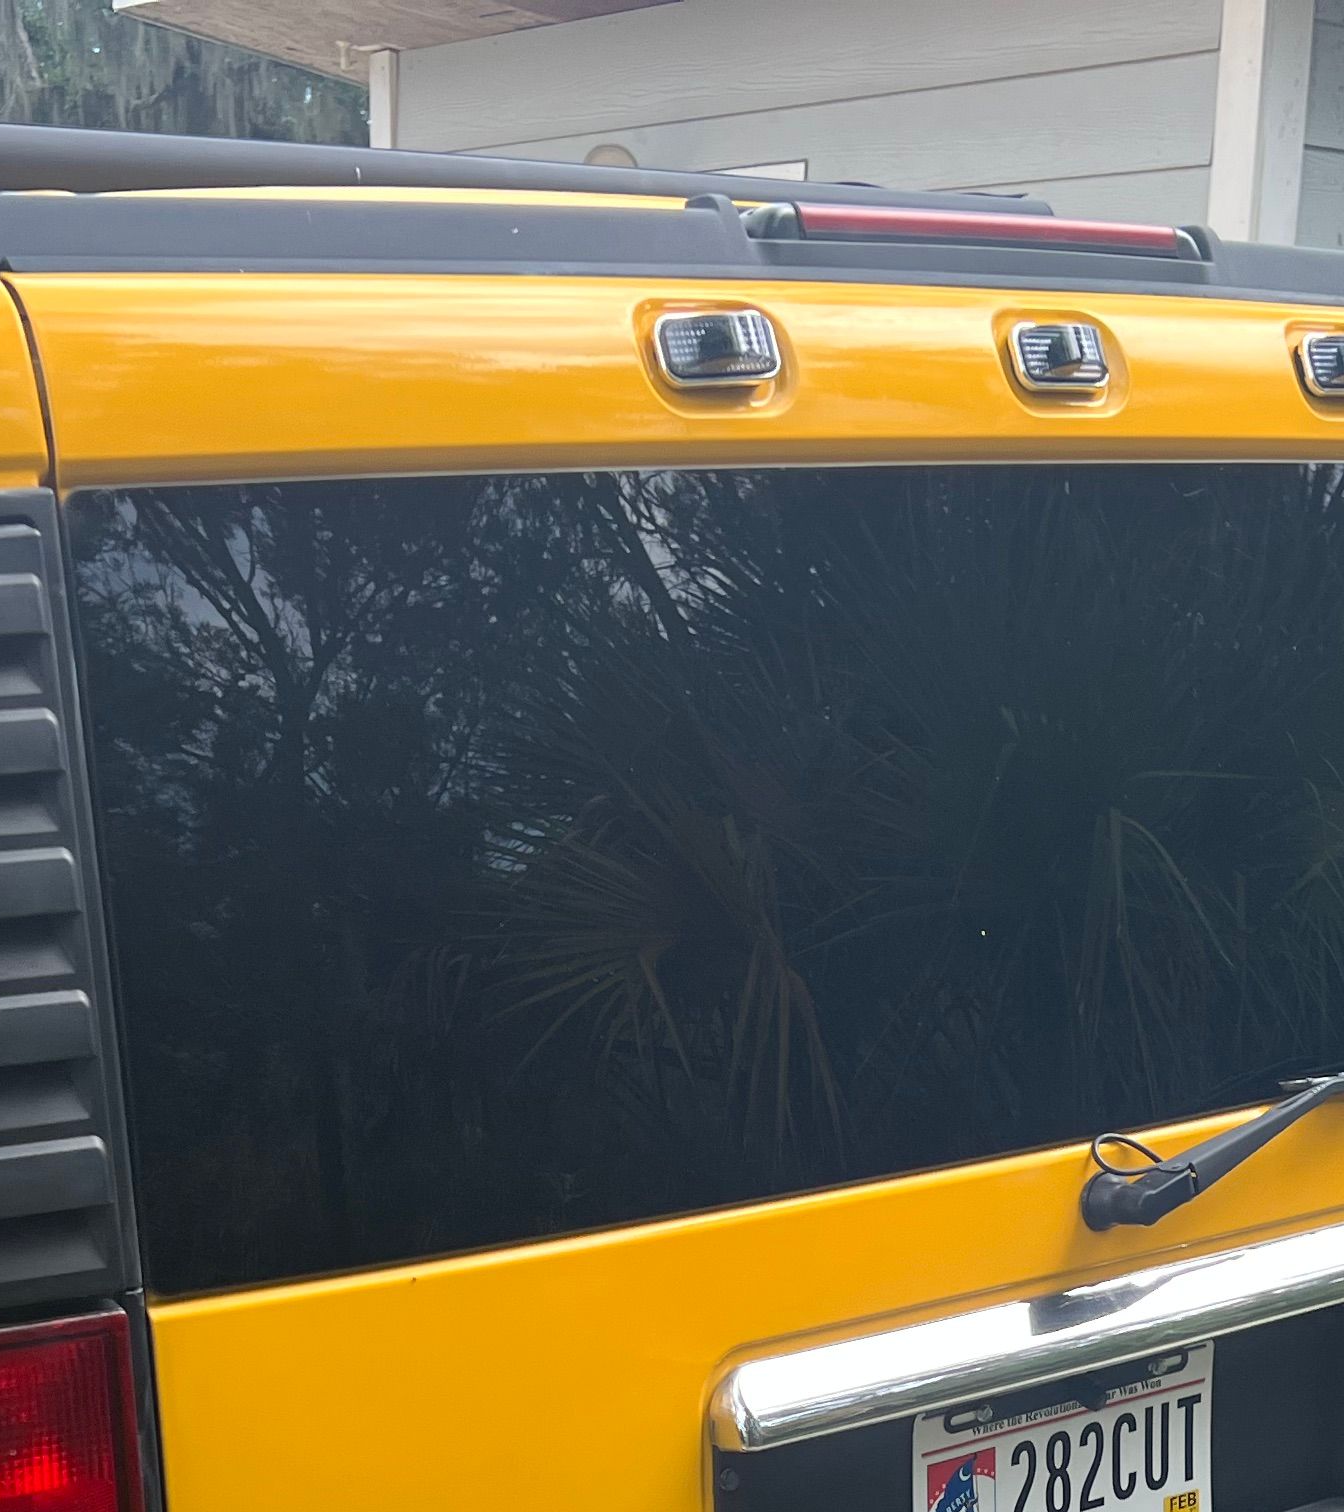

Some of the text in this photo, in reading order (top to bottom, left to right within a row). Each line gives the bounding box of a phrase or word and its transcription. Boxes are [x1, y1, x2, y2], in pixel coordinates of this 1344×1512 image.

[972, 1420, 1004, 1437] Where
[1025, 1401, 1081, 1423] Revolution
[1119, 1385, 1138, 1397] Was
[1141, 1379, 1162, 1391] Won
[1169, 1491, 1197, 1512] FEB
